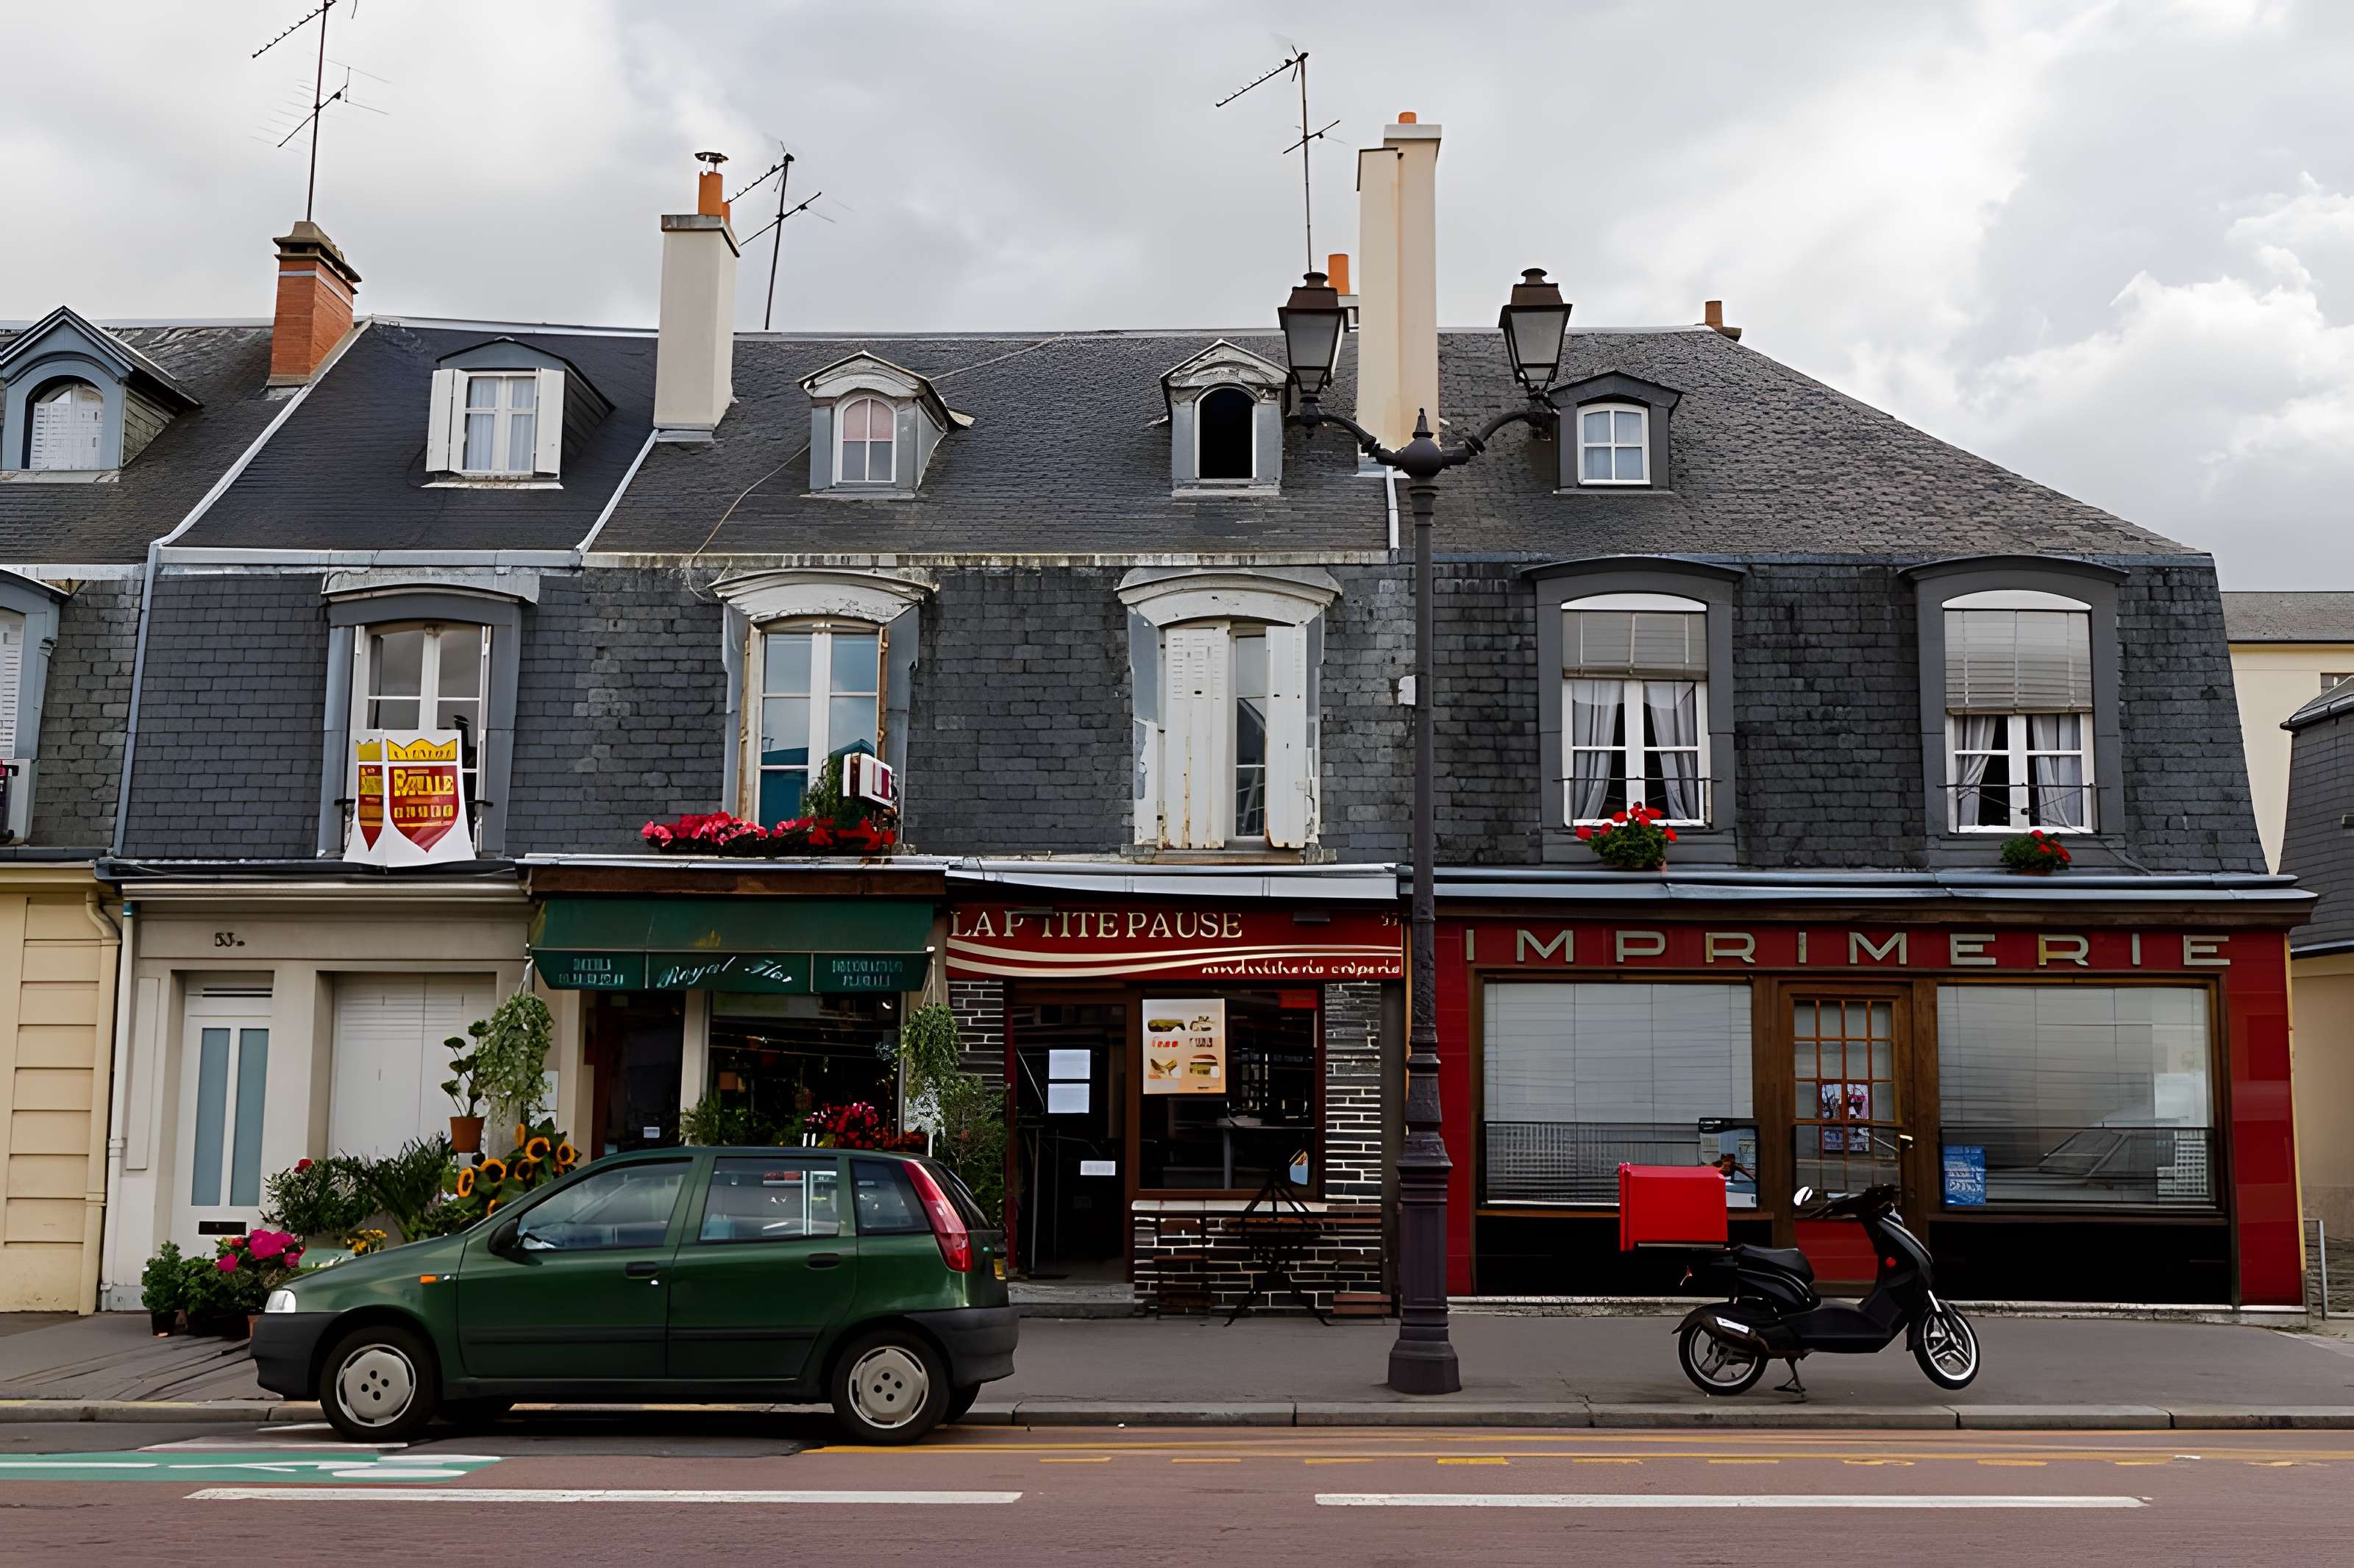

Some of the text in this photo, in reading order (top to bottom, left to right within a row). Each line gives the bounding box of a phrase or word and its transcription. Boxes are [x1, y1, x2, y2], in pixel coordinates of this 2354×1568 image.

[950, 911, 997, 938] LA
[1126, 912, 1242, 938] PAUSE
[1466, 928, 2231, 966] IMPRIMERIE
